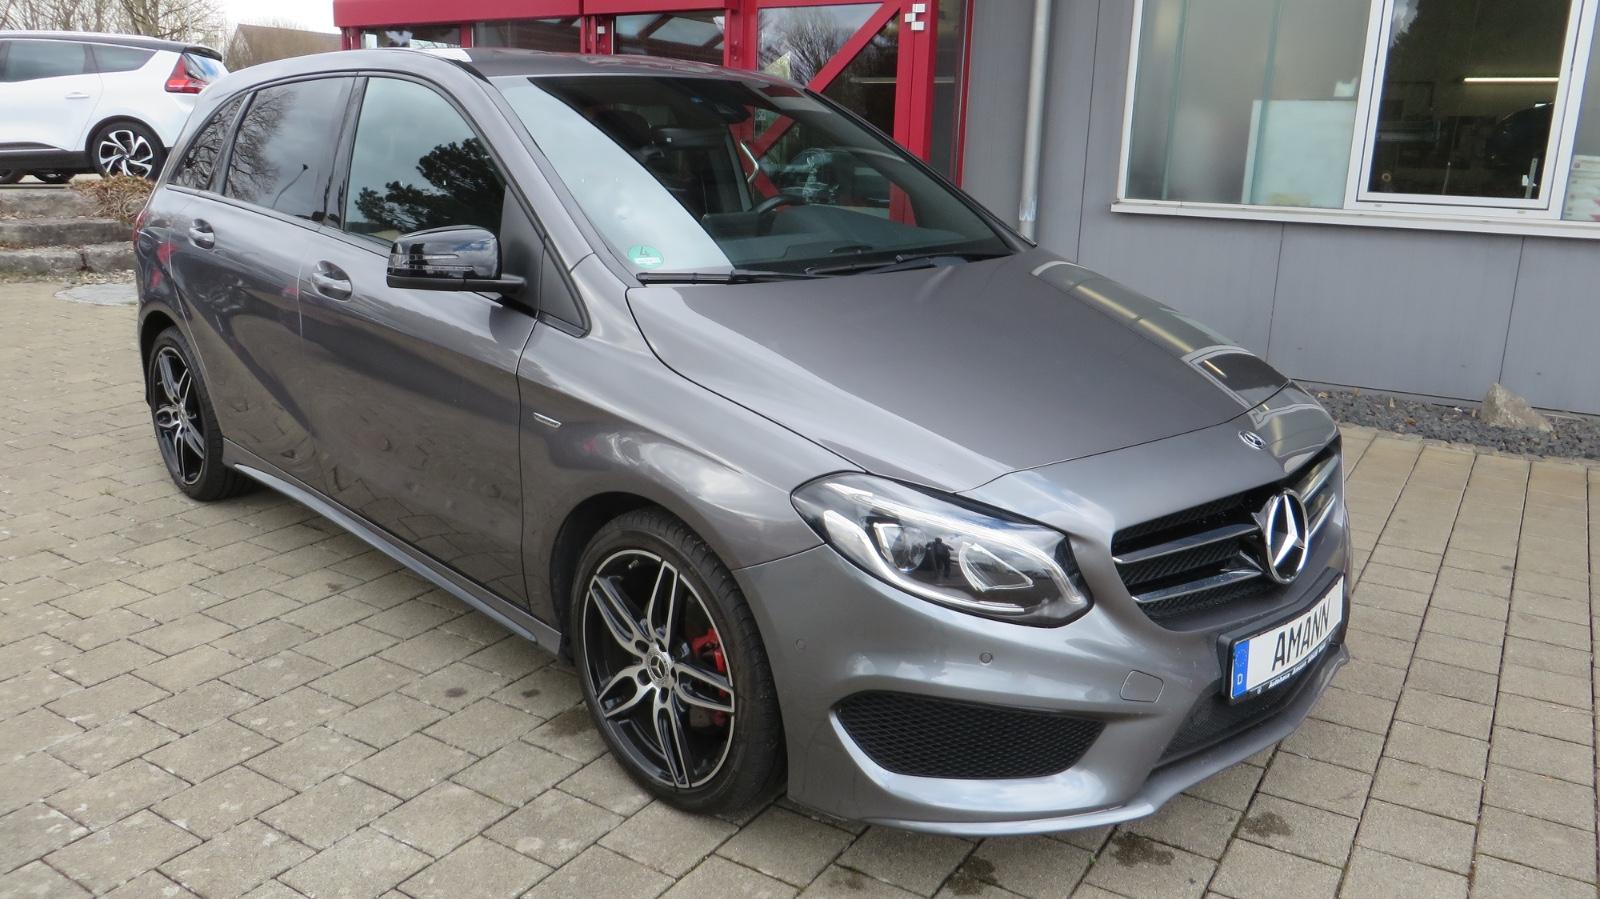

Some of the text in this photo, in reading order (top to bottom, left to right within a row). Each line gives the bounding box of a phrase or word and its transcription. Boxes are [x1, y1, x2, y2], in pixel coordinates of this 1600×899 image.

[639, 245, 650, 257] 4
[1237, 597, 1331, 685] D AMANN
